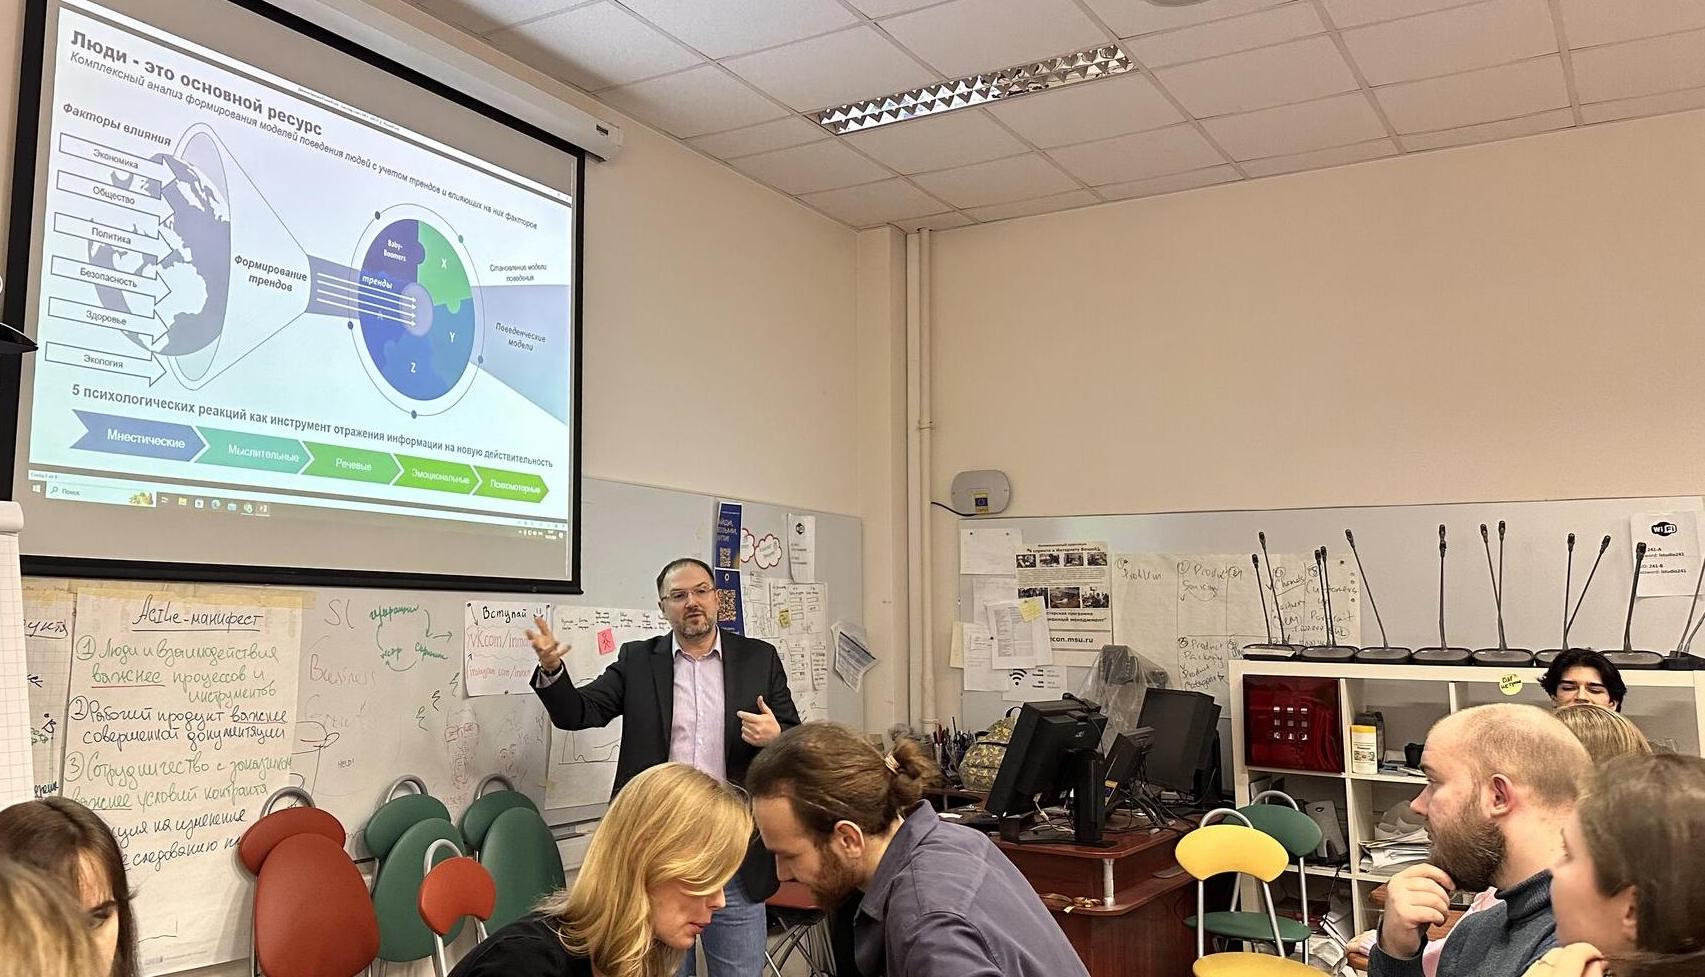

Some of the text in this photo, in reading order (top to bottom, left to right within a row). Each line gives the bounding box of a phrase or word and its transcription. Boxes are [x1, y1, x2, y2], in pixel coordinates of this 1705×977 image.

[71, 30, 127, 64] Люди
[144, 59, 175, 81] это
[181, 73, 263, 115] основной
[268, 106, 322, 137] ресурс
[63, 103, 171, 147] Факторы влияния
[70, 51, 145, 86] Комплексный
[147, 80, 183, 100] анализ
[186, 93, 257, 128] формирования
[259, 121, 299, 142] моделей
[300, 135, 344, 159] поведения
[344, 152, 371, 170] людей
[371, 163, 377, 171] с
[378, 164, 408, 183] учетом
[409, 176, 441, 195] трендов
[448, 191, 482, 210] влияющих
[483, 205, 492, 213] на
[492, 208, 504, 218] них
[505, 211, 538, 230] факторов
[93, 148, 139, 170] Экономика
[92, 186, 135, 206] Общество
[91, 226, 132, 245] Политика
[79, 267, 138, 289] Безопасность
[234, 255, 308, 283] Формирование
[248, 274, 293, 293] трендов
[362, 275, 393, 290] тренды
[86, 310, 127, 326] Здоровье
[495, 321, 546, 343] Поведенческие
[508, 338, 534, 352] модели
[83, 353, 124, 369] Экология
[72, 383, 553, 468] 5 психологических реакций как инструмент отражения информации на новую действительность
[106, 428, 186, 449] Мнестические
[228, 444, 300, 464] Мыслительные
[335, 457, 372, 472] Речевые
[411, 468, 470, 485] Эмоциональные
[482, 605, 527, 623] Вступай
[173, 668, 247, 693] процессов
[157, 710, 225, 731] продукт
